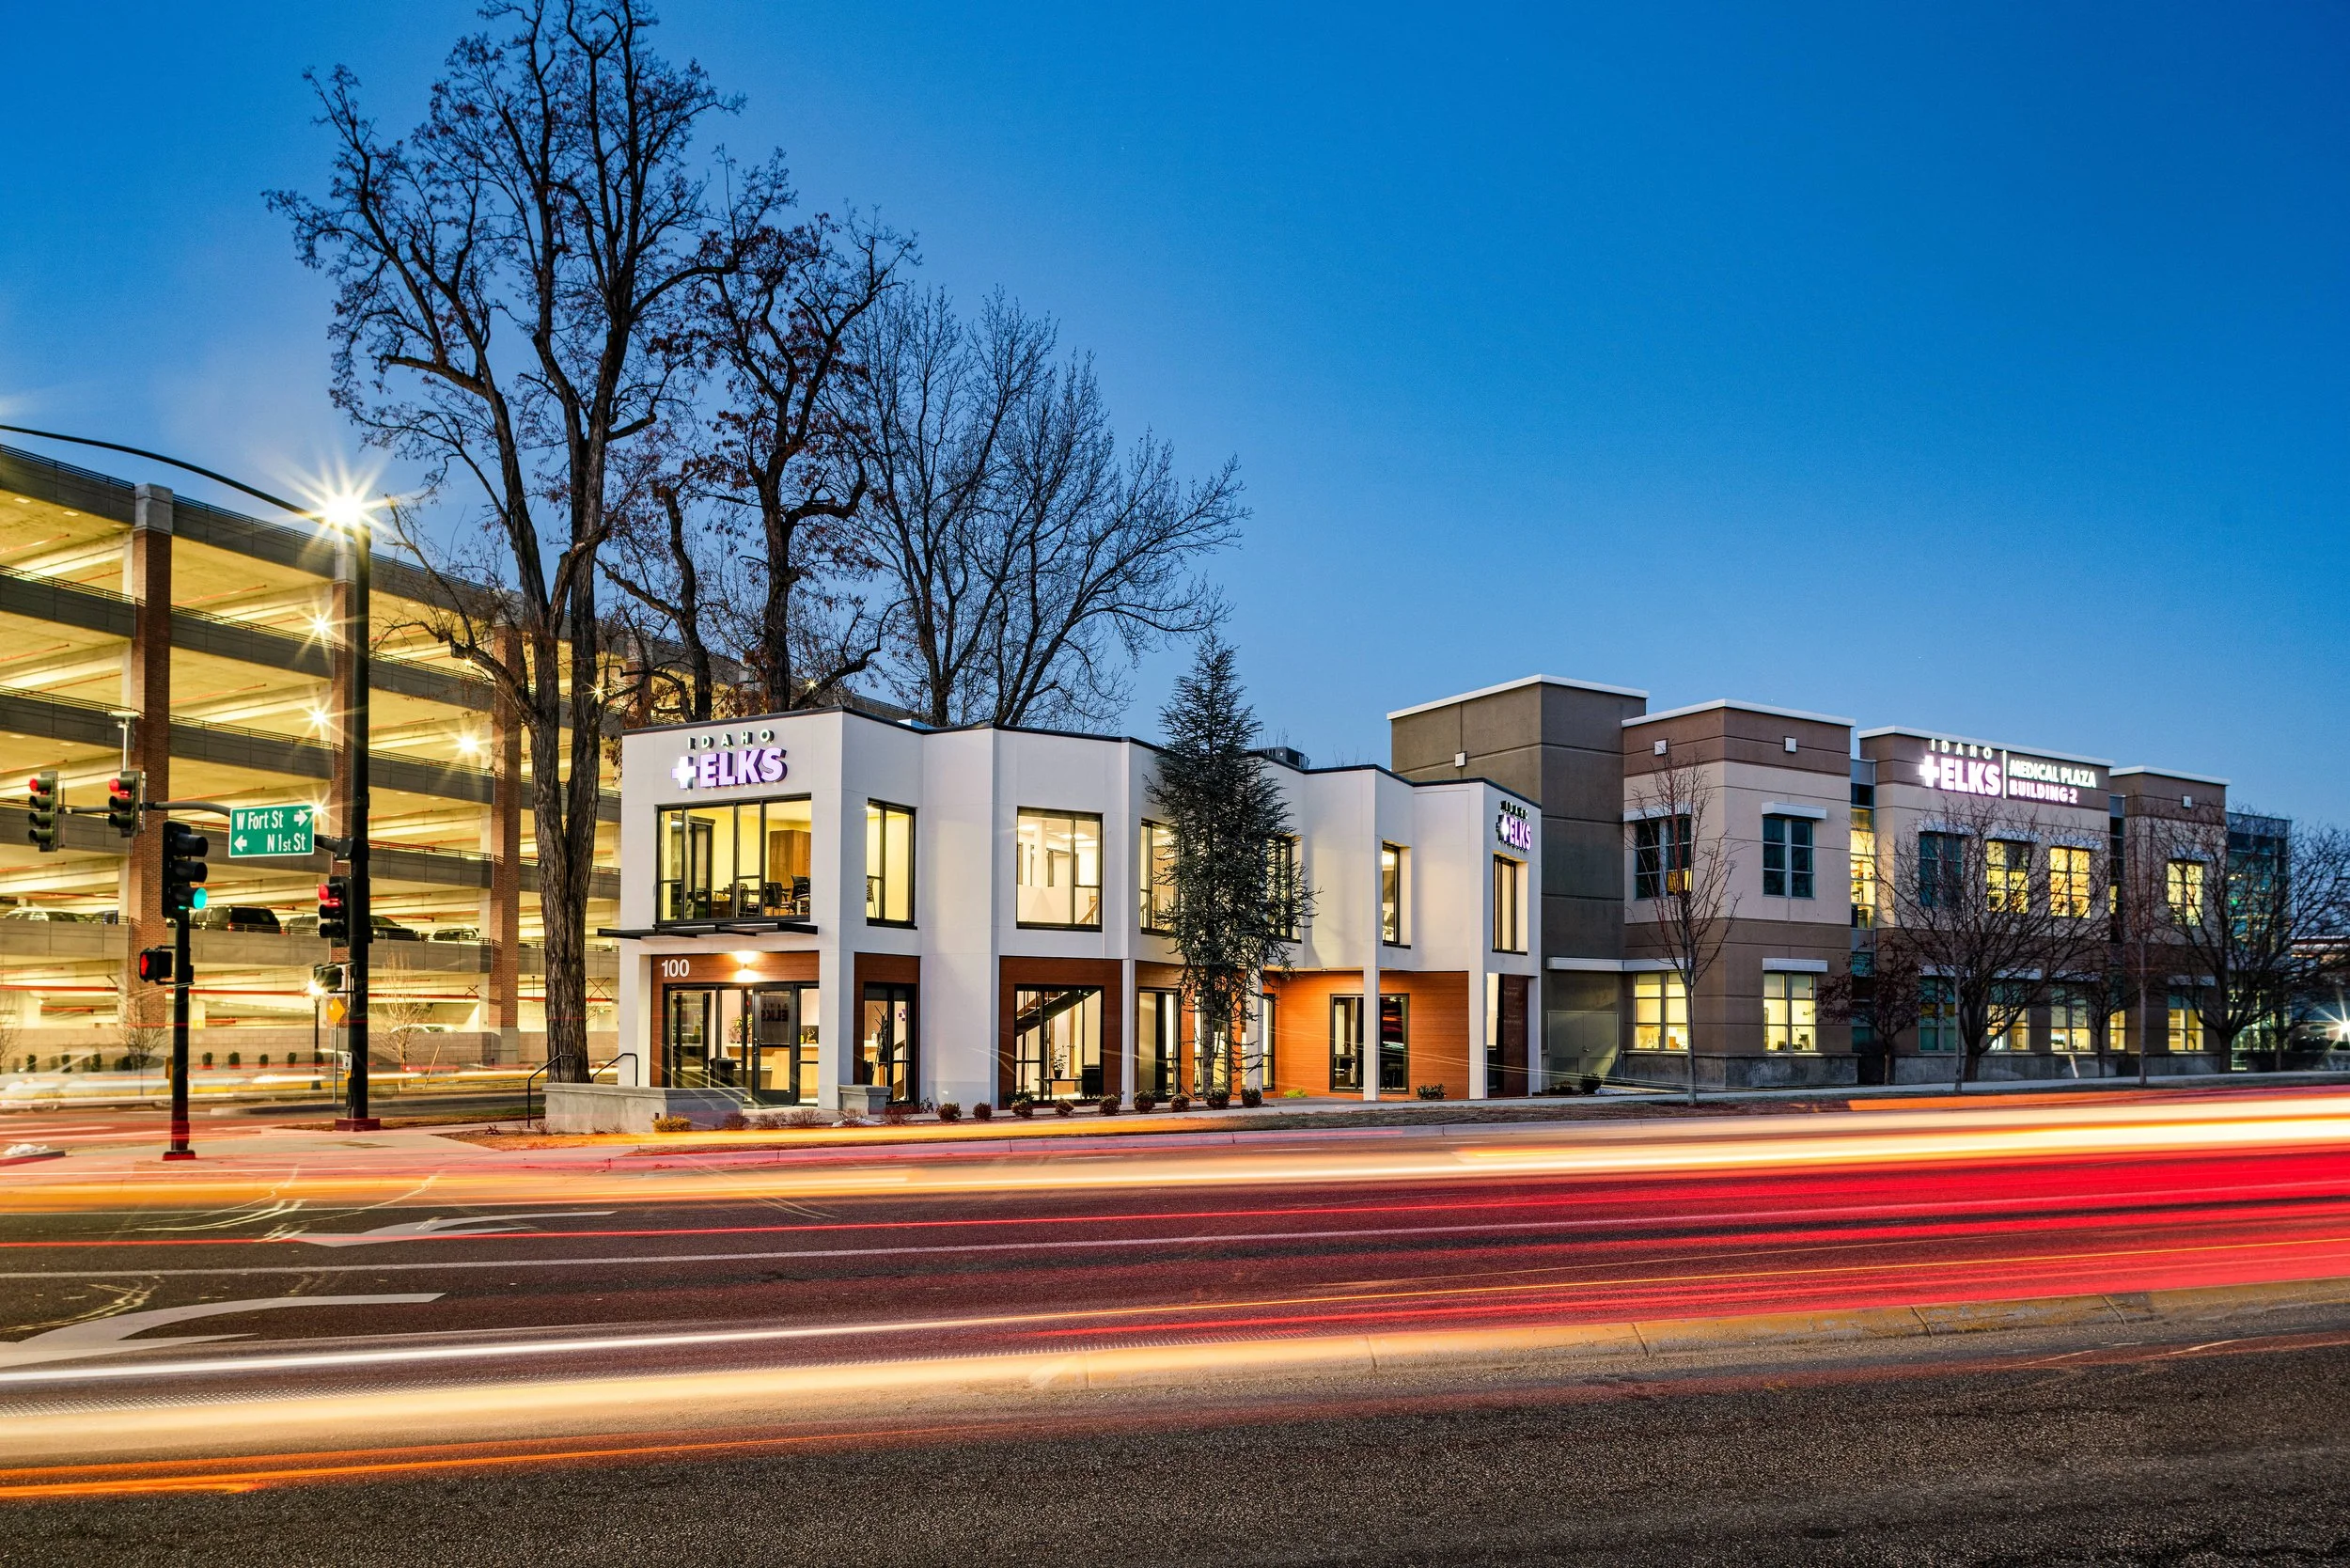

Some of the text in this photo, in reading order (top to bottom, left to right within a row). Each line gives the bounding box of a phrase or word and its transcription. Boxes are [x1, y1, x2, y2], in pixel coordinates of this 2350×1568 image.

[687, 729, 775, 750] IDAHO
[1931, 738, 1992, 760] IDAHO
[699, 747, 788, 788] ELKS
[1940, 757, 2001, 796] ELKS
[2009, 759, 2097, 788] MEDICAL PLAZA
[2009, 779, 2078, 804] BUILDING 2
[236, 809, 284, 830] W Fort St
[266, 832, 306, 853] N 1st St
[1510, 816, 1531, 851] ELKS
[661, 959, 690, 978] 100
